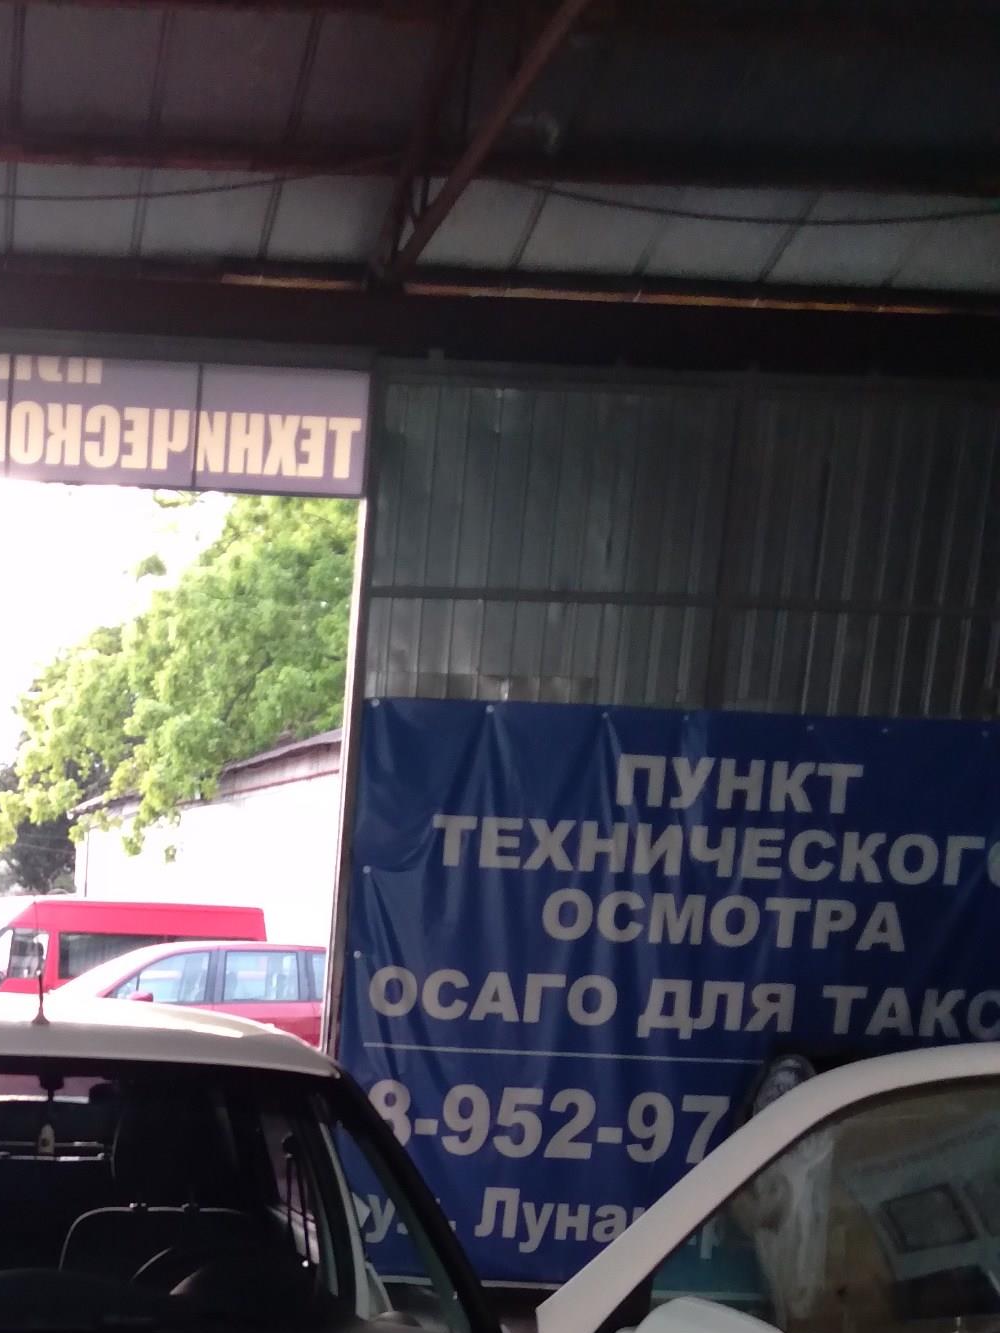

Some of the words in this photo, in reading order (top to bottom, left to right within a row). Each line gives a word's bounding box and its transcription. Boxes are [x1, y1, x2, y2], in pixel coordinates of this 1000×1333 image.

[615, 755, 864, 814] ПУНКТ
[432, 814, 1000, 885] ТЕХНИЧЕСКОГ
[541, 887, 904, 951] ОСМОТРА
[368, 965, 617, 1025] ОСАГО
[636, 978, 796, 1039] ДЛЯ
